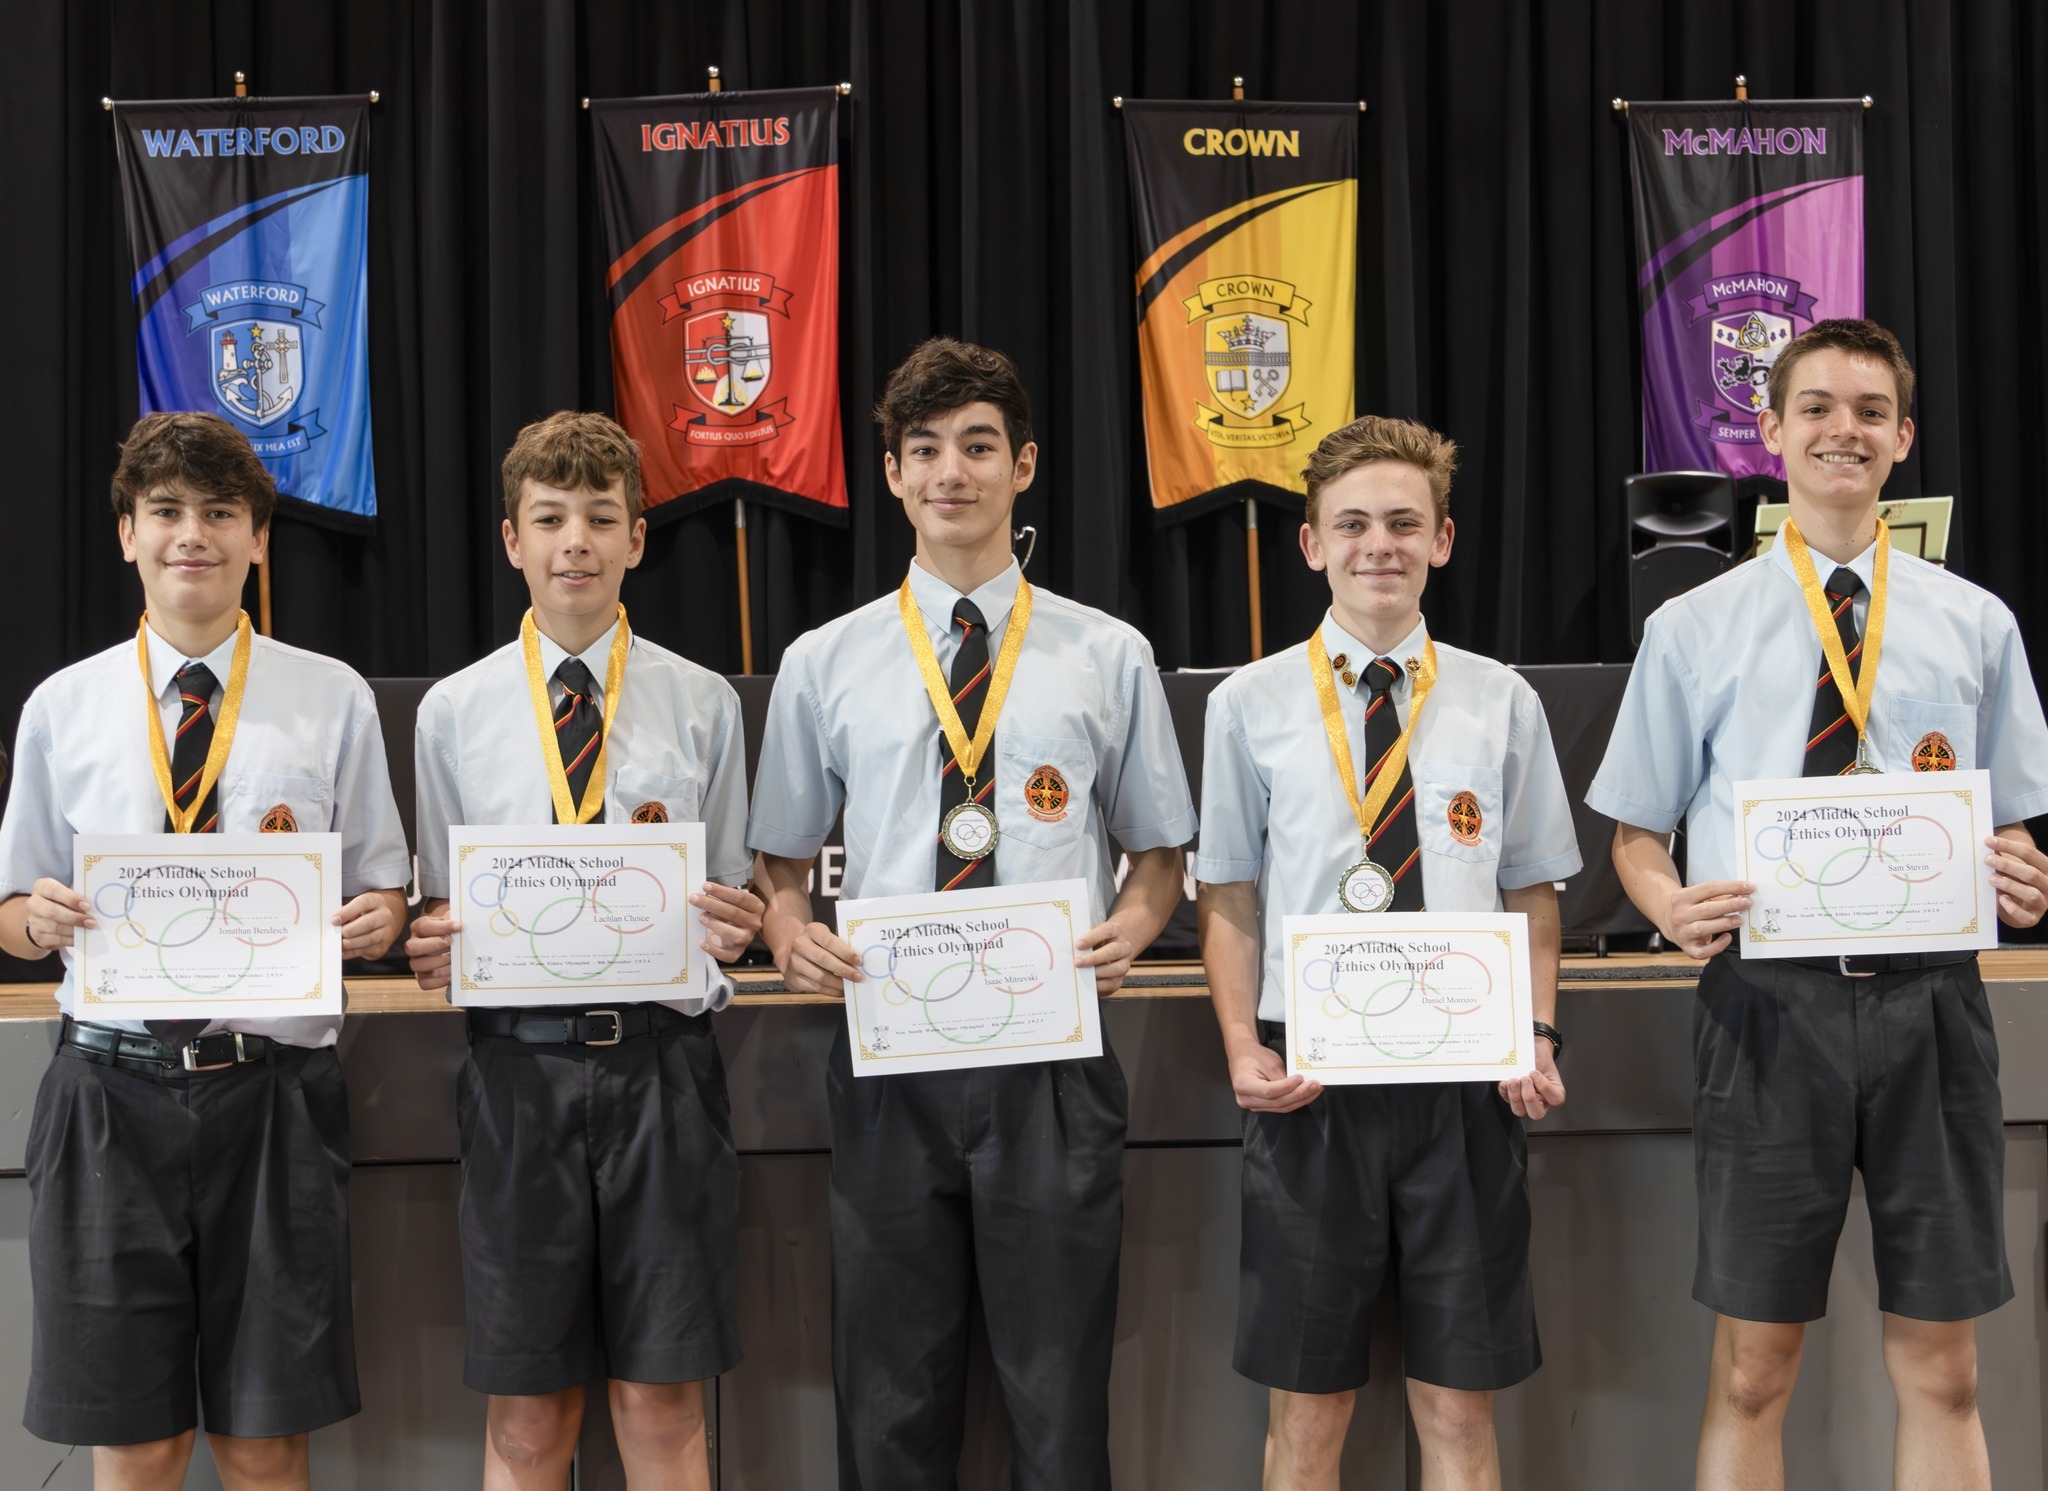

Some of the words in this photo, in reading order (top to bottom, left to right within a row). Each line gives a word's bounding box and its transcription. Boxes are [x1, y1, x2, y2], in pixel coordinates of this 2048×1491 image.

[142, 126, 345, 158] WATERFORD
[641, 117, 790, 152] IGNATIUS
[1184, 128, 1300, 157] CROWN
[1663, 127, 1826, 156] McMAHON
[206, 286, 299, 305] WATERFORD
[687, 277, 760, 298] IGNATIUS
[1216, 281, 1274, 298] CROWN
[1713, 279, 1788, 298] McMAHON
[690, 430, 721, 440] FORTIUS
[724, 432, 743, 441] QUO
[1718, 427, 1756, 439] SEMPER
[266, 442, 285, 452] MEA
[287, 437, 300, 448] EST
[1776, 811, 1807, 822] 2024
[1812, 808, 1859, 821] Middle
[1864, 805, 1909, 819] School
[1789, 828, 1830, 840] Ethics
[1835, 825, 1902, 841] Olympiad
[492, 857, 523, 869] 2024
[528, 856, 575, 869] Middle
[580, 856, 624, 868] School
[119, 867, 151, 879] 2024
[156, 866, 206, 879] Middle
[210, 866, 256, 879] School
[503, 876, 545, 888] Ethics
[550, 875, 616, 890] Olympiad
[131, 887, 174, 899] Ethics
[179, 886, 249, 901] Olympiad
[880, 927, 910, 941] 2024
[914, 923, 961, 938] Middle
[965, 918, 1009, 934] School
[893, 944, 934, 959] Ethics
[938, 938, 1003, 955] Olympiad
[1324, 944, 1353, 955] 2024
[1358, 943, 1404, 954] Middle
[1408, 942, 1450, 953] School
[1335, 961, 1375, 972] Ethics
[1380, 959, 1444, 973] Olympiad
